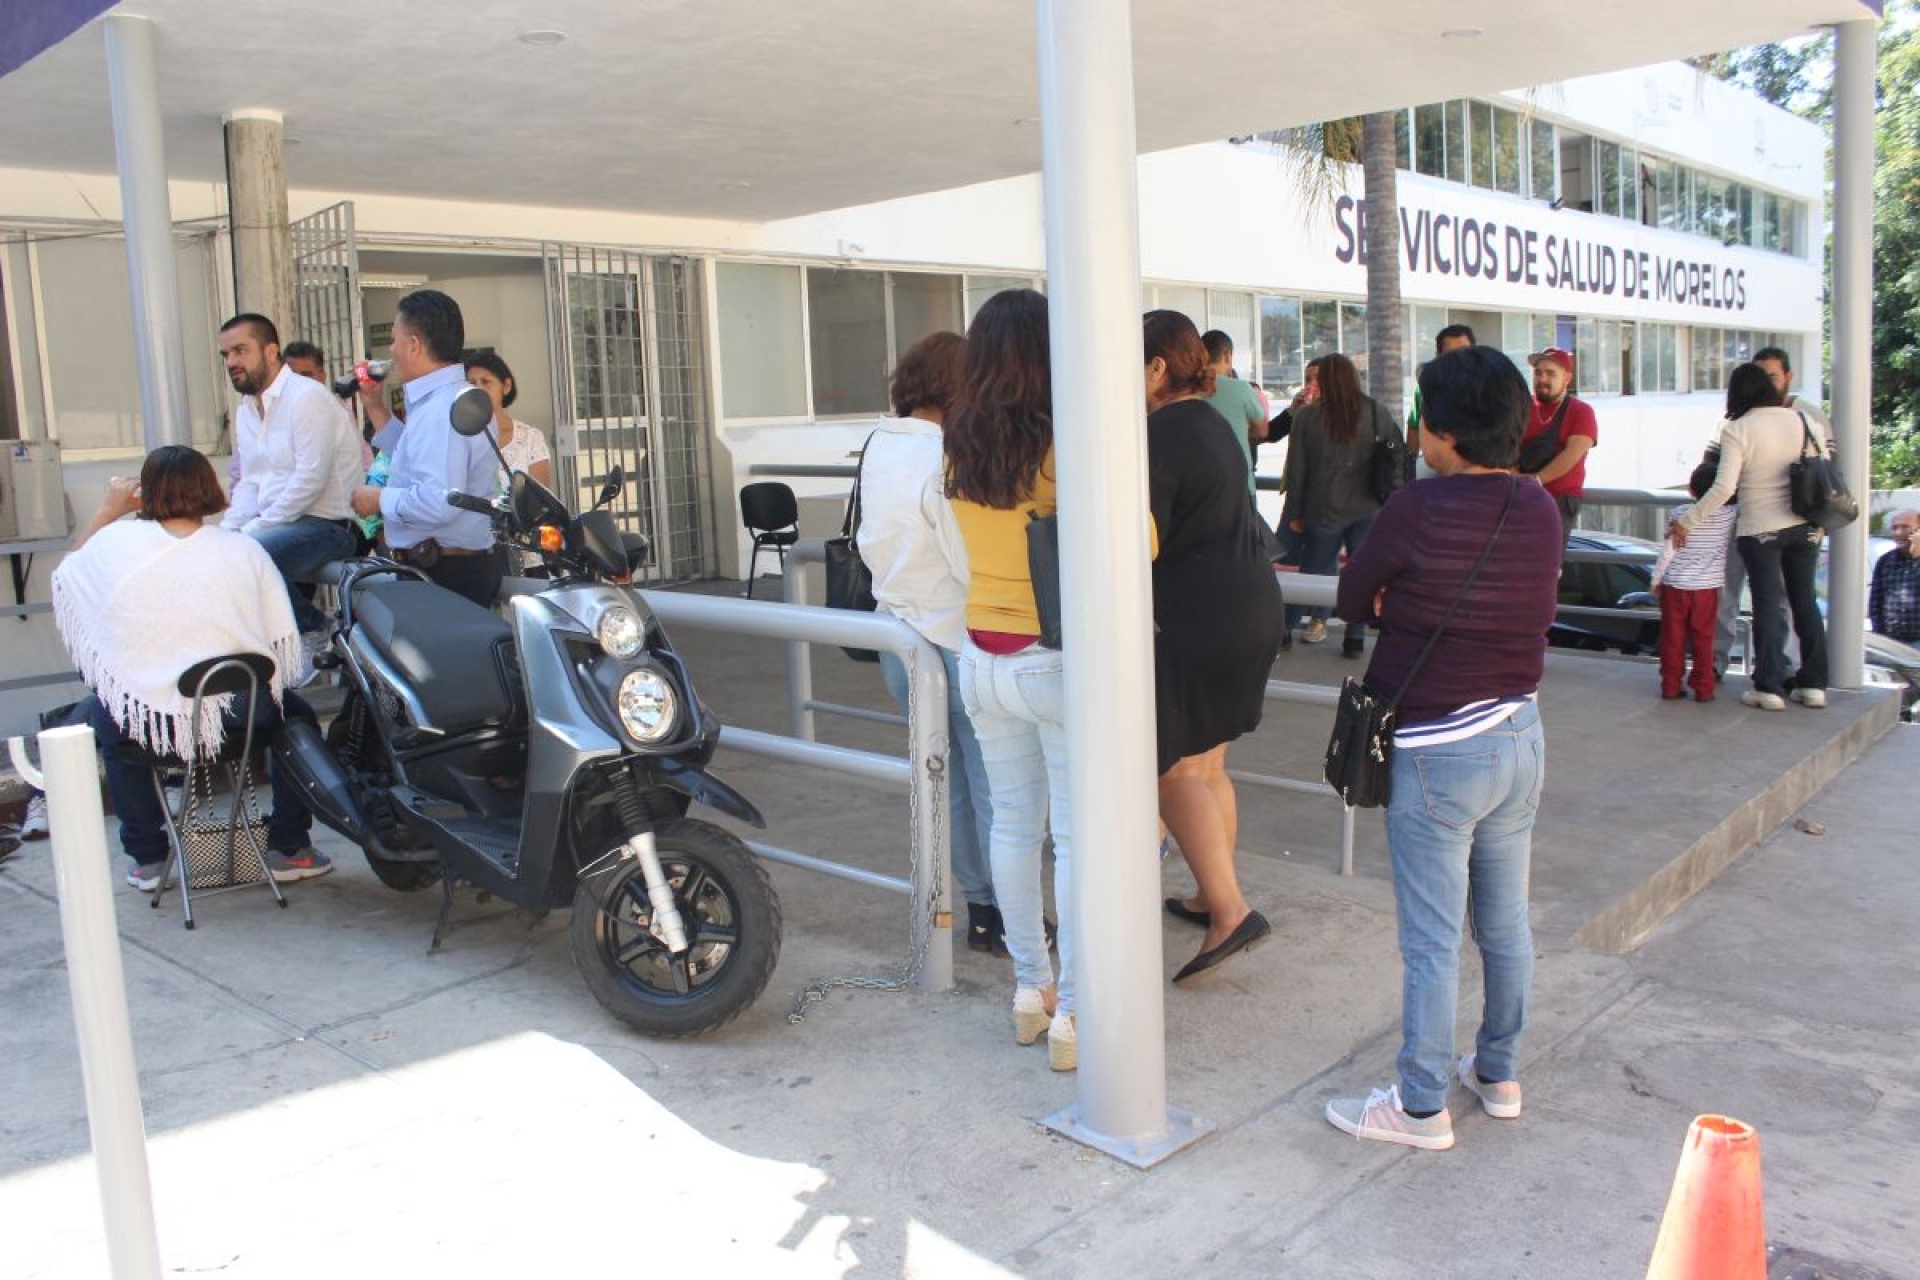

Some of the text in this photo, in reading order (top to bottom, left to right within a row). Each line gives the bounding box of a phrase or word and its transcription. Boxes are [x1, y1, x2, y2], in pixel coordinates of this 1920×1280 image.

[1335, 194, 1745, 311] SEVICIOS DE SALUD DE MORELOS
